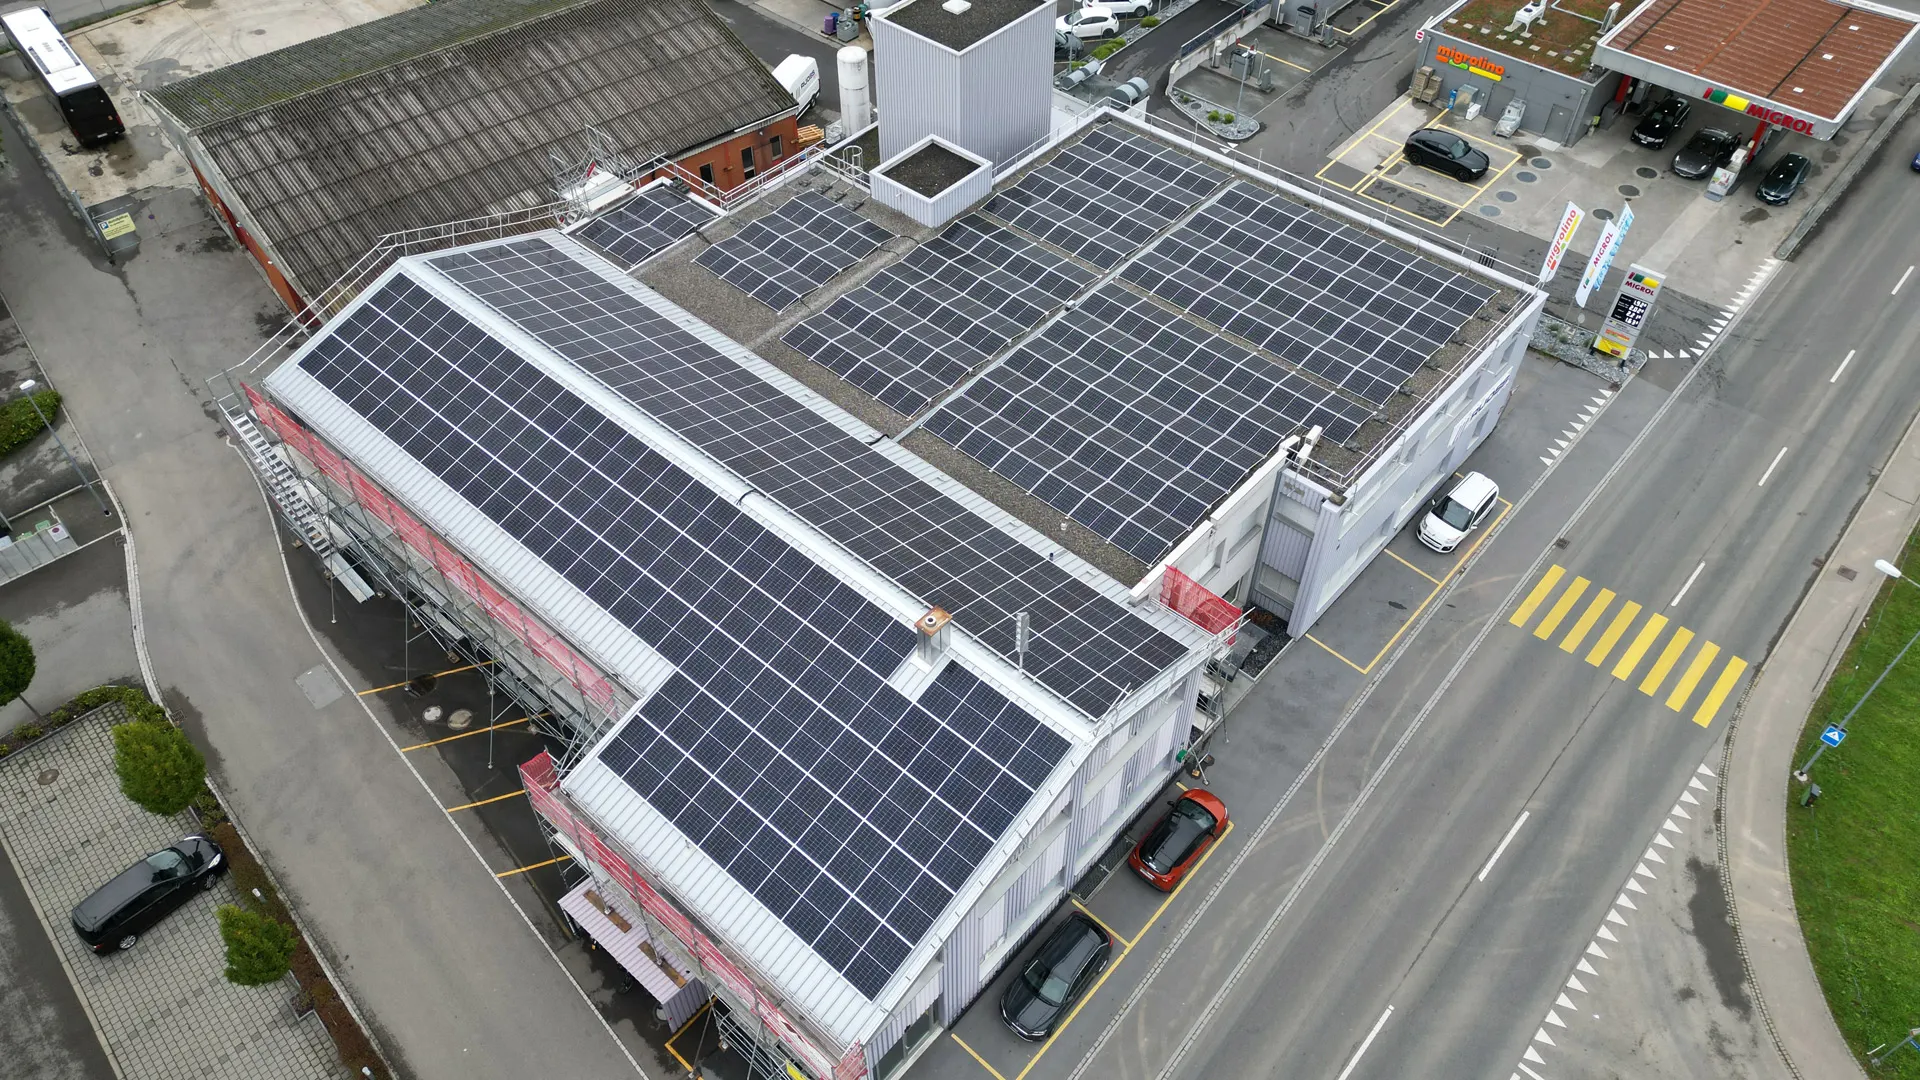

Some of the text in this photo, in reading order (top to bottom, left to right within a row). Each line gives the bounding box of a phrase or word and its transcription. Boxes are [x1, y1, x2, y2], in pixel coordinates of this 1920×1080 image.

[1437, 45, 1505, 75] migrolino
[1746, 103, 1814, 136] MIGROL
[1546, 209, 1577, 268] migrolino
[1593, 232, 1613, 267] MIGROL
[1625, 281, 1654, 296] MIGROL
